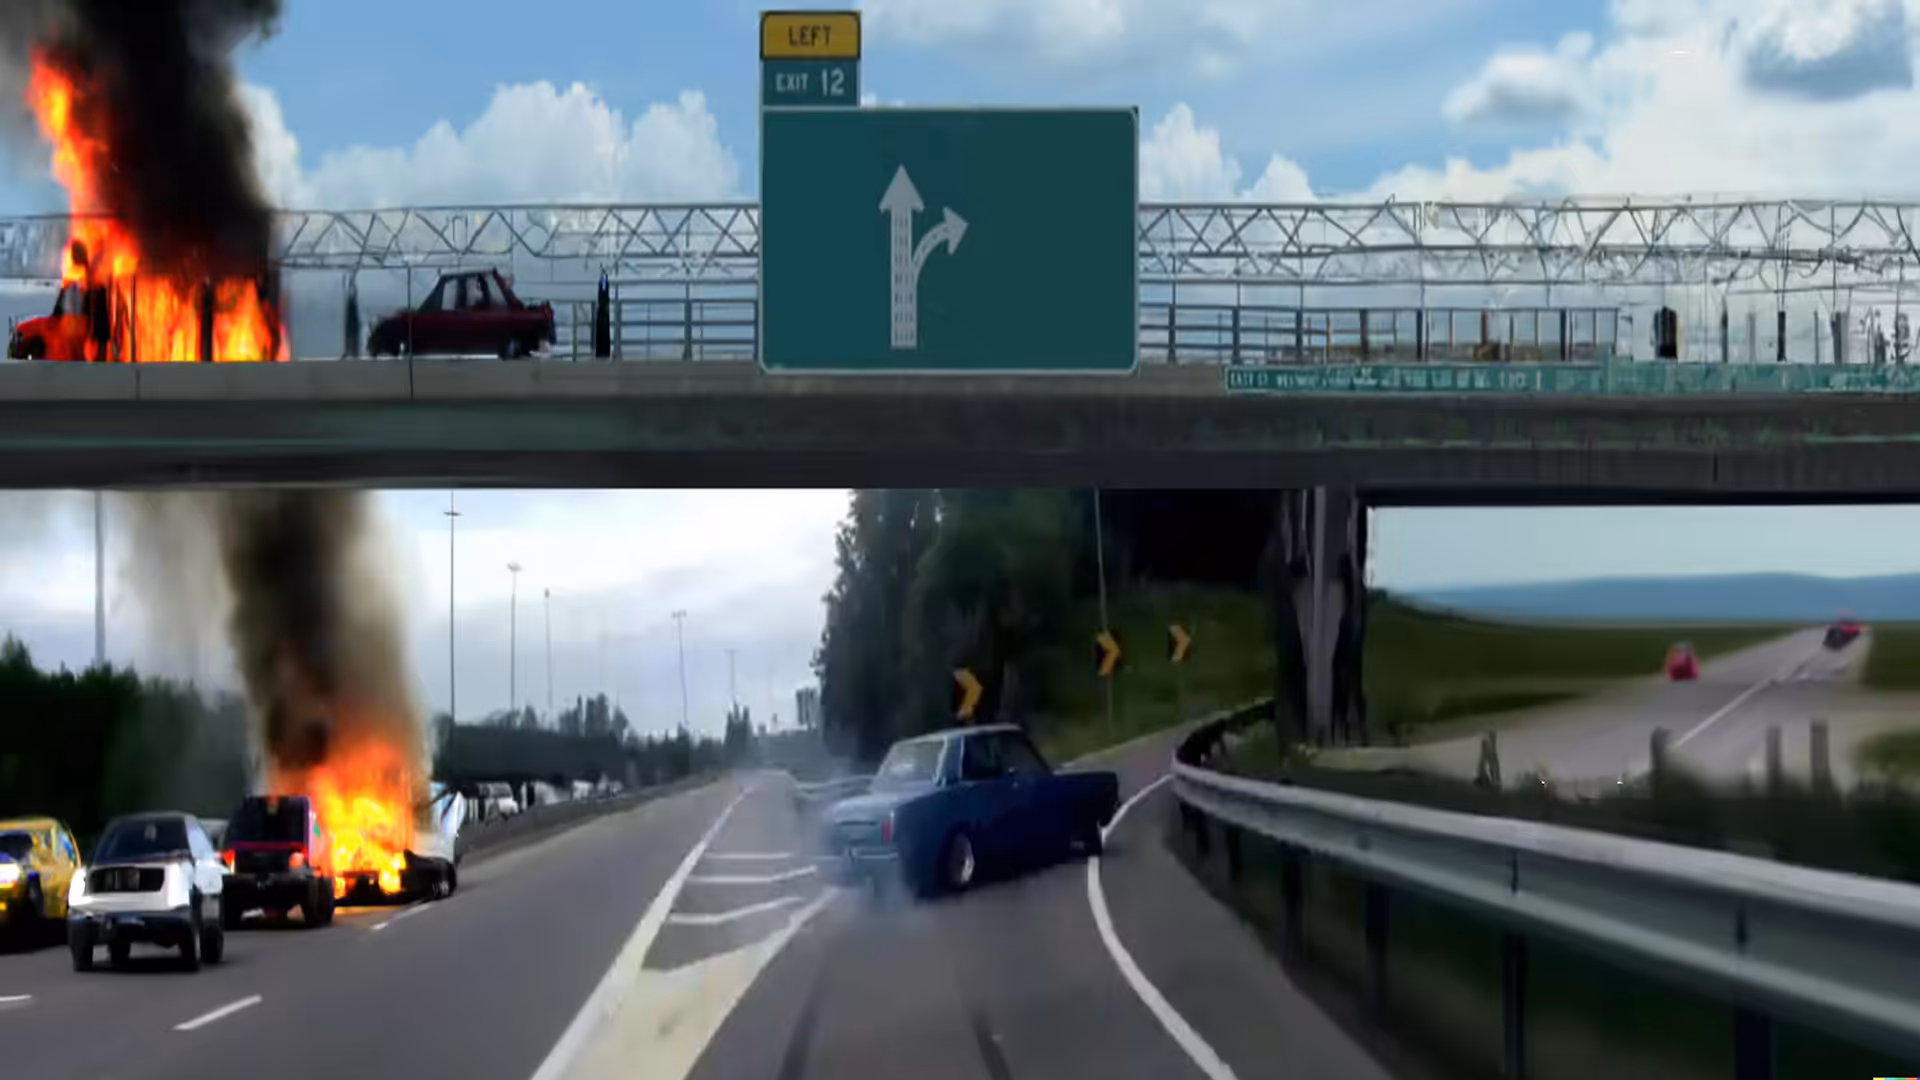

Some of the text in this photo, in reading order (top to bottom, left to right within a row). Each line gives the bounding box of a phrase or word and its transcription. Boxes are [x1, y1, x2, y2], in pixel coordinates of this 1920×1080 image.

[789, 24, 832, 47] LEFT
[775, 68, 846, 96] EXIT 12
